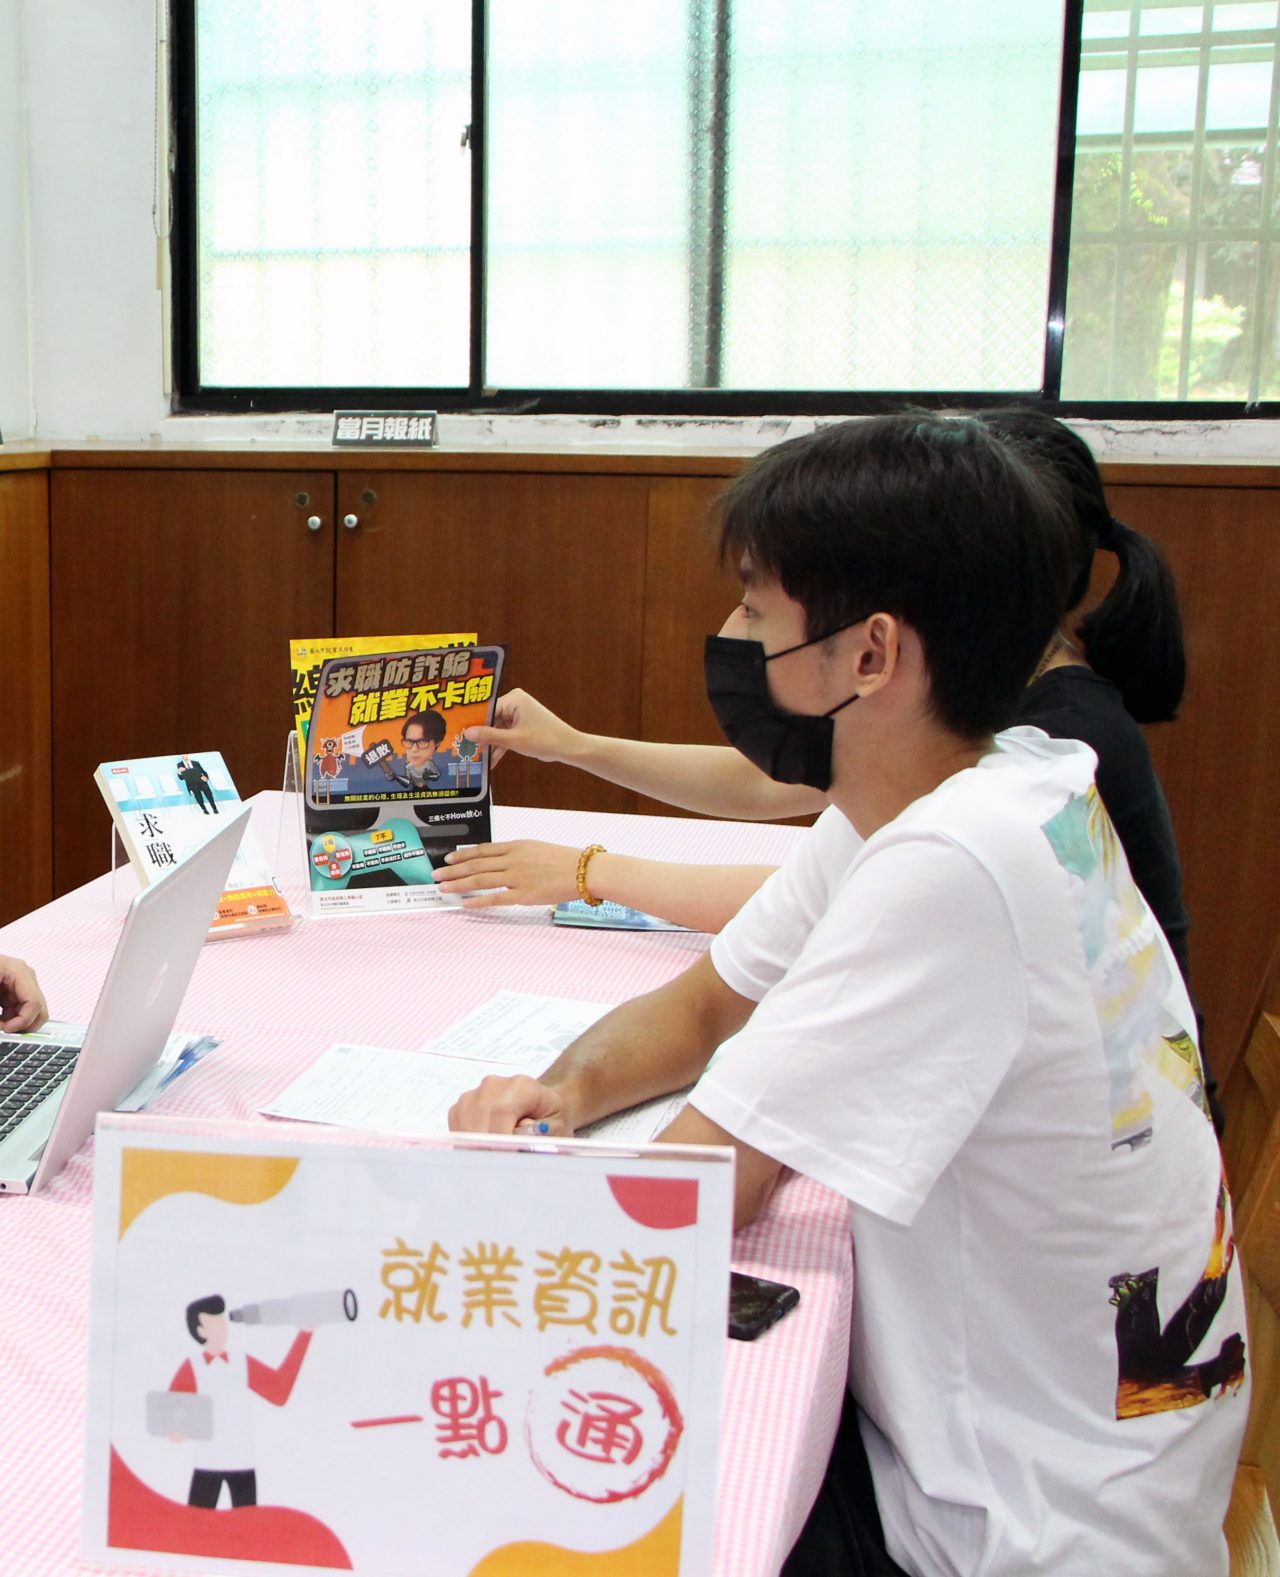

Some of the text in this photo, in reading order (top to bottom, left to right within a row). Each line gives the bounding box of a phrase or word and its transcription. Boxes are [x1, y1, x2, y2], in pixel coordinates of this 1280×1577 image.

[336, 417, 433, 440] 當月報紙
[326, 648, 472, 697] 求職防詐騙
[349, 675, 494, 726] 就業不卡關
[365, 743, 391, 765] 退散
[139, 813, 178, 868] 求職
[378, 1236, 678, 1338] 就業資訊
